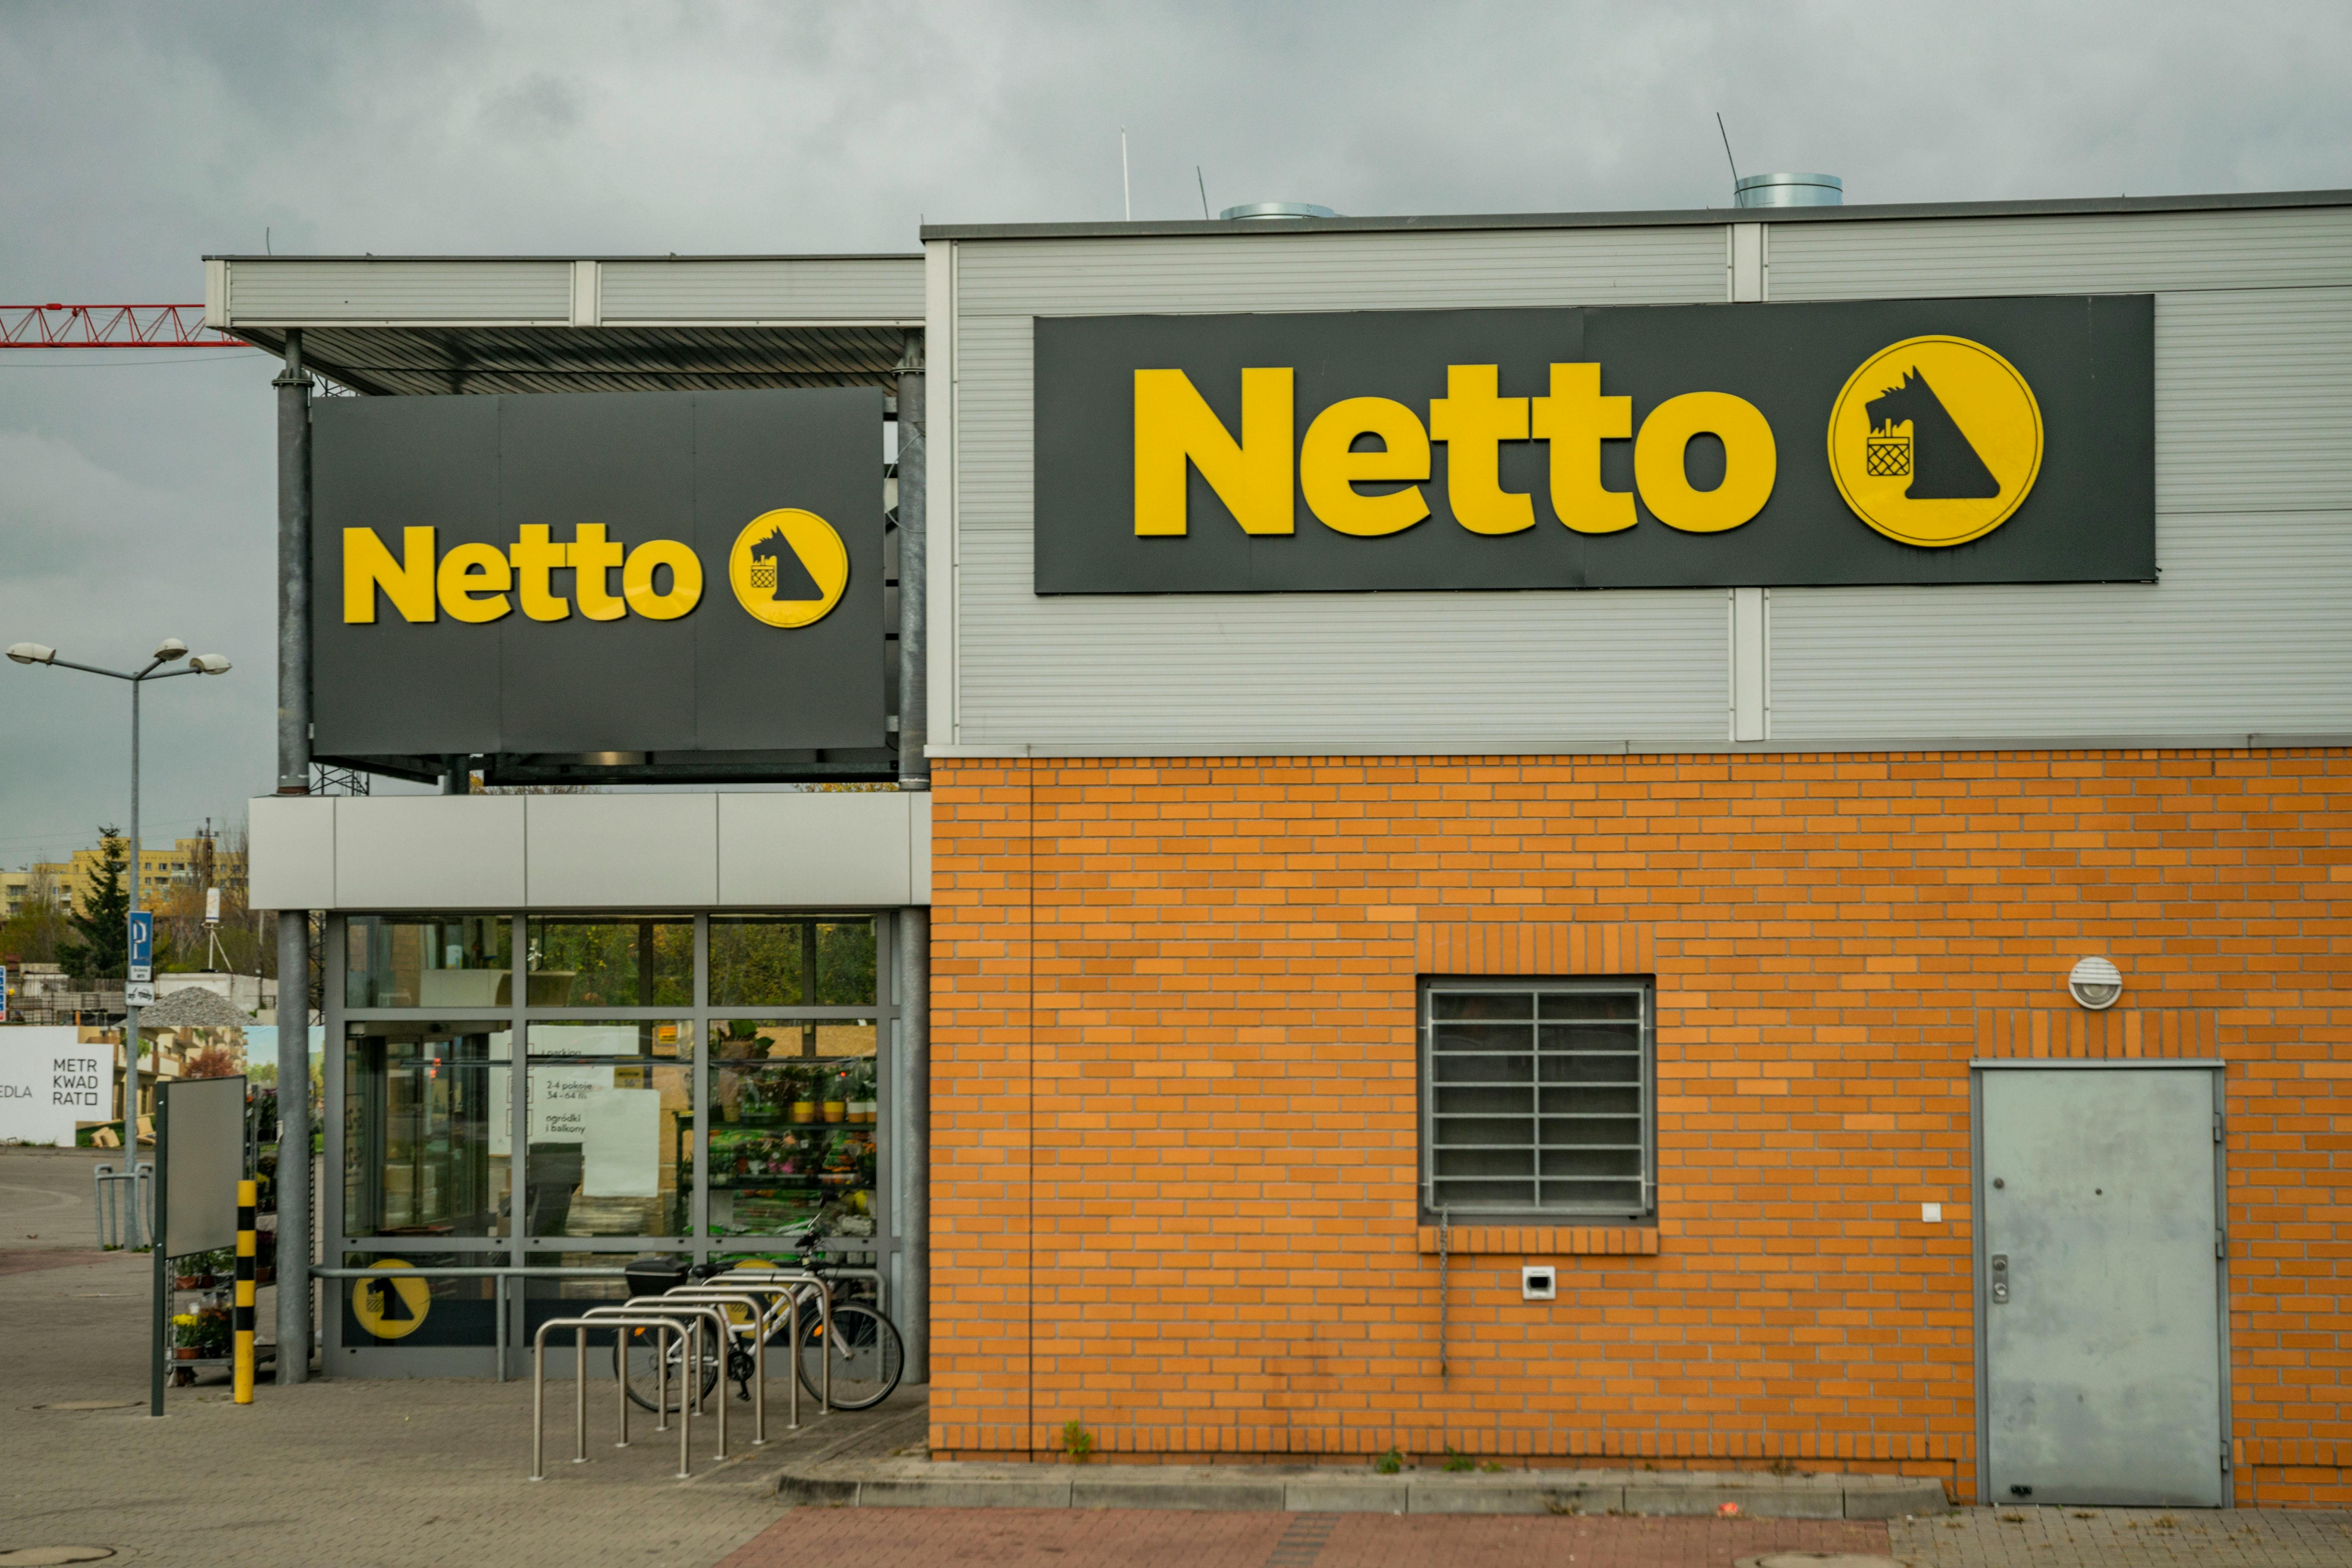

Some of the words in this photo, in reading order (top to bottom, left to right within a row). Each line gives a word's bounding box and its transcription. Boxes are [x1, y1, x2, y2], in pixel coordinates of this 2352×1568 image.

[1134, 363, 1777, 536] Netto
[343, 523, 702, 623] Netto
[53, 1058, 97, 1072] METR
[53, 1076, 98, 1089] KWAD
[546, 1113, 581, 1124] ogródki
[545, 1123, 549, 1132] i
[551, 1123, 586, 1135] balkony
